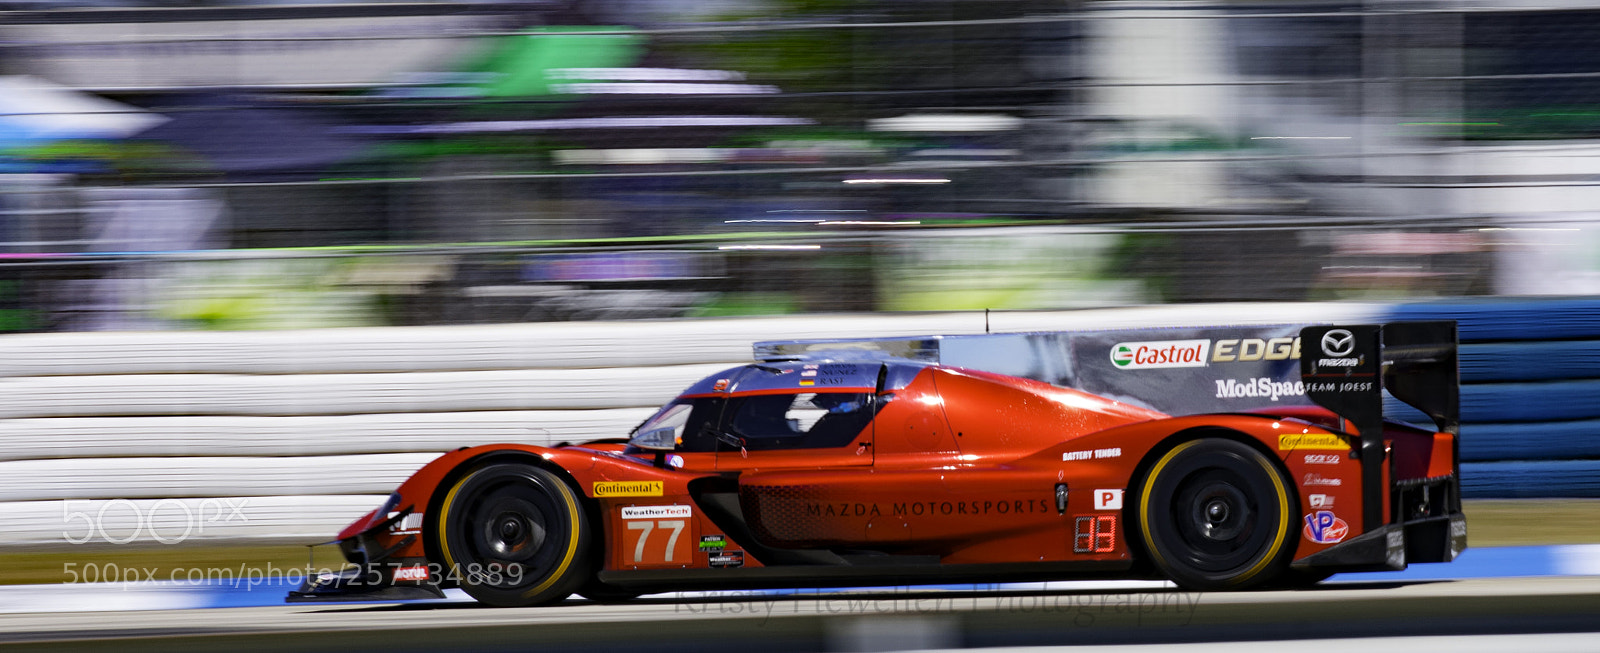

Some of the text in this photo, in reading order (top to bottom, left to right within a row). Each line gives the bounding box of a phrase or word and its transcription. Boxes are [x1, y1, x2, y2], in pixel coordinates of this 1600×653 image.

[1135, 344, 1202, 365] Castrol
[1306, 382, 1373, 393] TEAM JOEST
[1063, 447, 1122, 461] BATTERY TENDER
[594, 483, 652, 496] Continental
[1101, 492, 1114, 507] P
[624, 508, 689, 517] WeatherTech
[807, 500, 1048, 517] MAZDA MOTORSPORTS
[627, 520, 685, 563] 77
